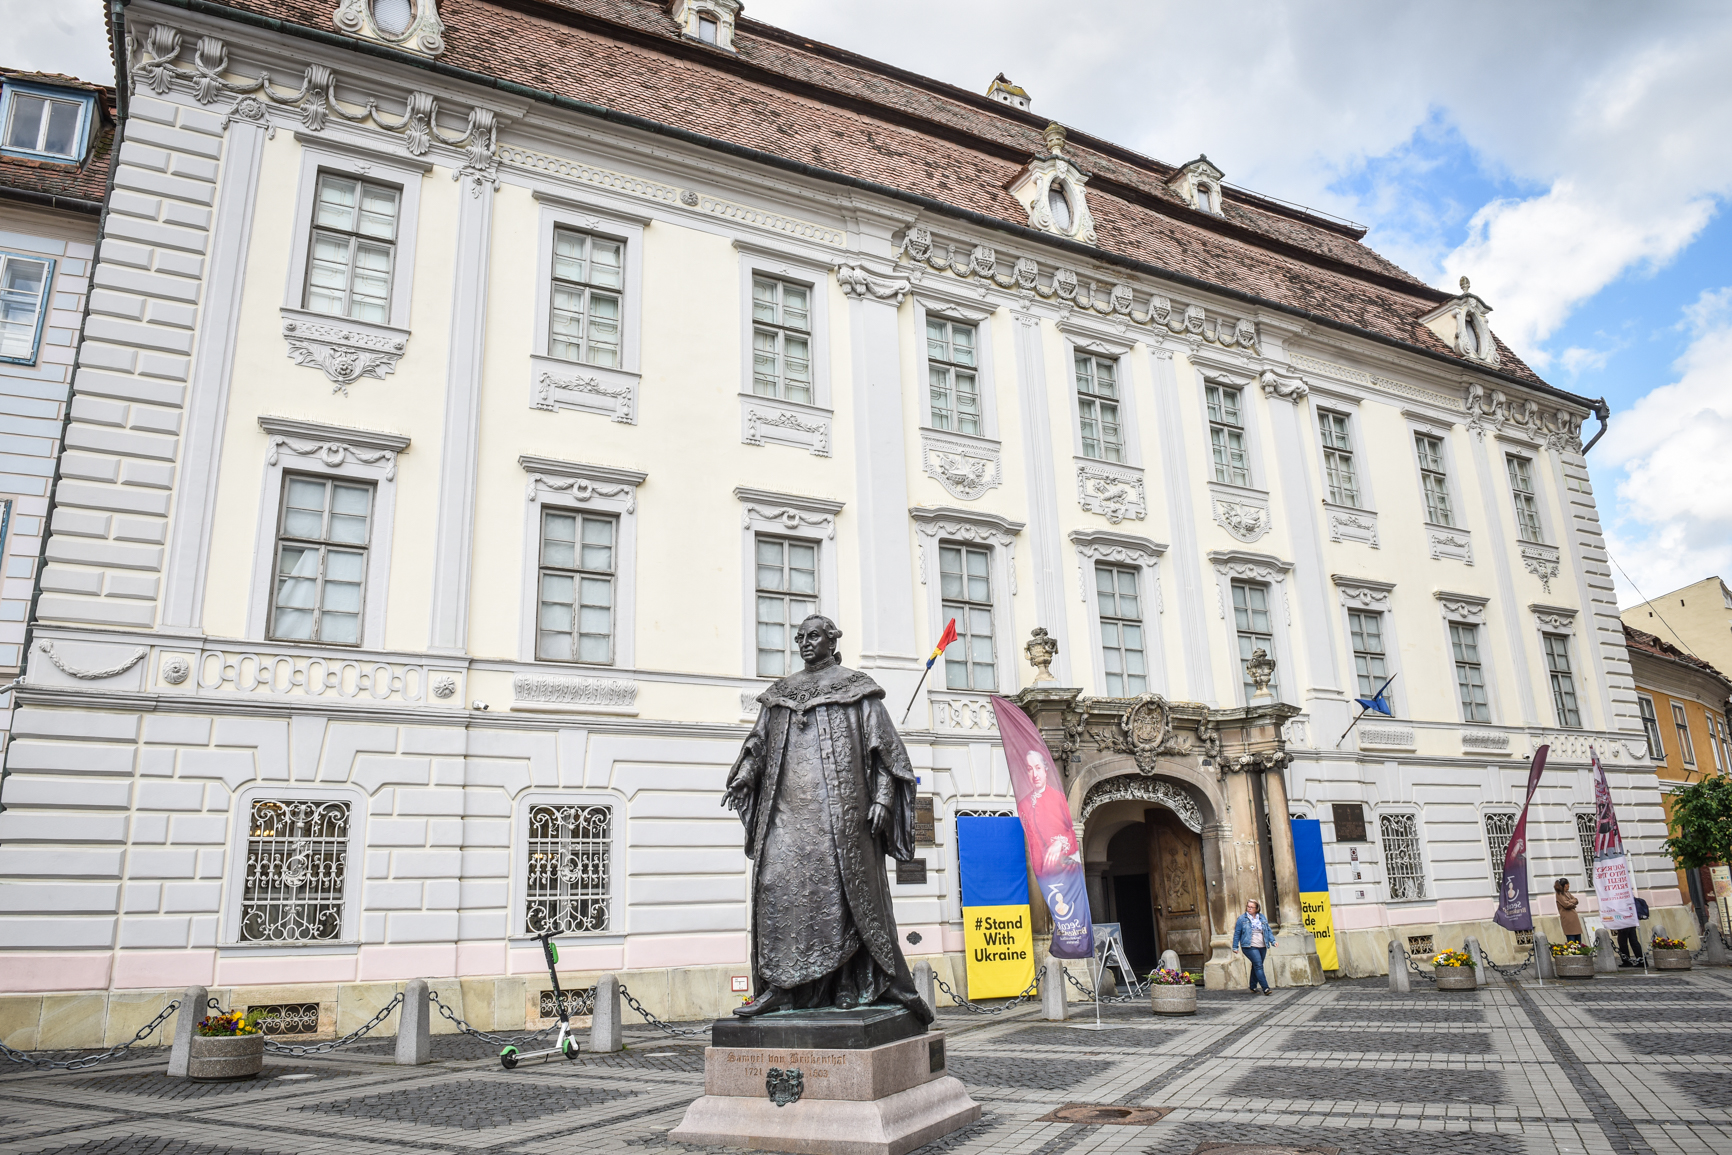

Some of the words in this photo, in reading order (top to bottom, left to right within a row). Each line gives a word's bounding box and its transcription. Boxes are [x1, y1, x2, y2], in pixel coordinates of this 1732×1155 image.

[1302, 901, 1324, 913] ături
[975, 915, 1022, 930] #Stand
[1304, 914, 1316, 926] de
[983, 930, 1015, 946] With
[974, 946, 1027, 963] Ukraine
[727, 1052, 764, 1064] Samuel
[768, 1054, 785, 1064] von
[789, 1052, 846, 1066] Brukenthal
[744, 1067, 763, 1077] 1721
